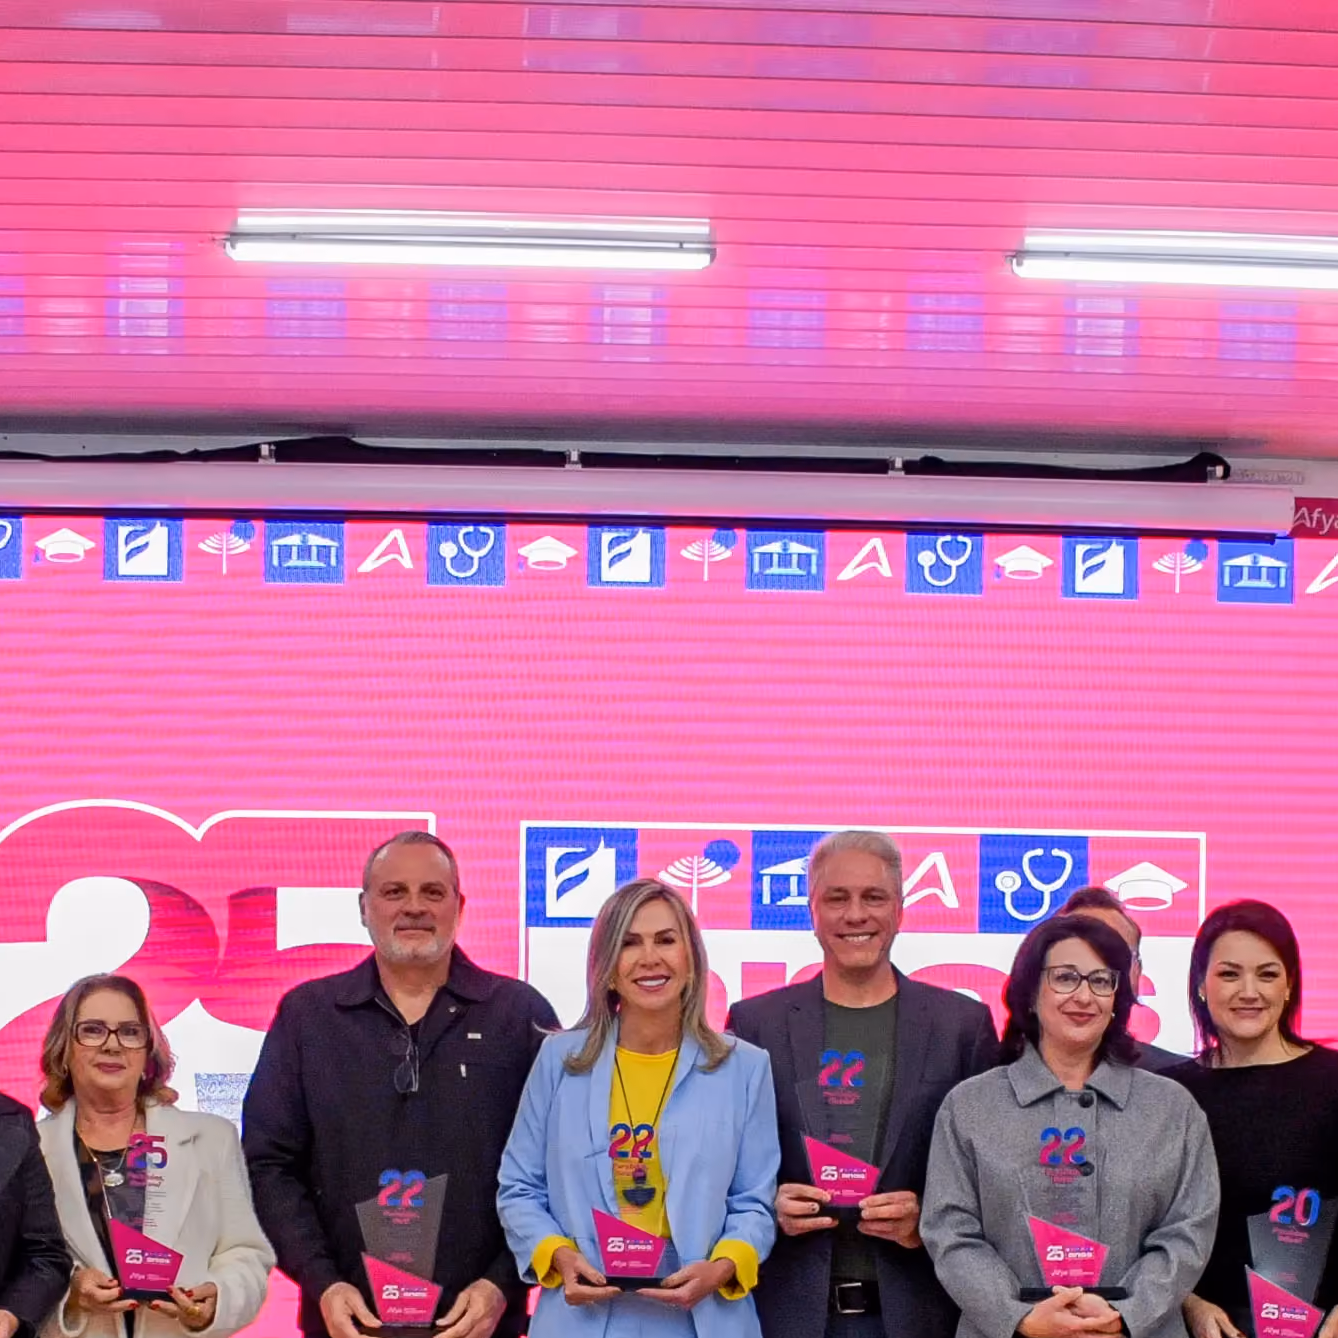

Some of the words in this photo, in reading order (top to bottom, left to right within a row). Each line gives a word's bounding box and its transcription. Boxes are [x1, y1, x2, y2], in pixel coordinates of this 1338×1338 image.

[818, 1049, 865, 1087] 22
[127, 1132, 168, 1169] 25
[608, 1123, 655, 1158] 22
[1039, 1127, 1086, 1164] 22
[377, 1169, 427, 1207] 22
[1269, 1185, 1321, 1227] 20
